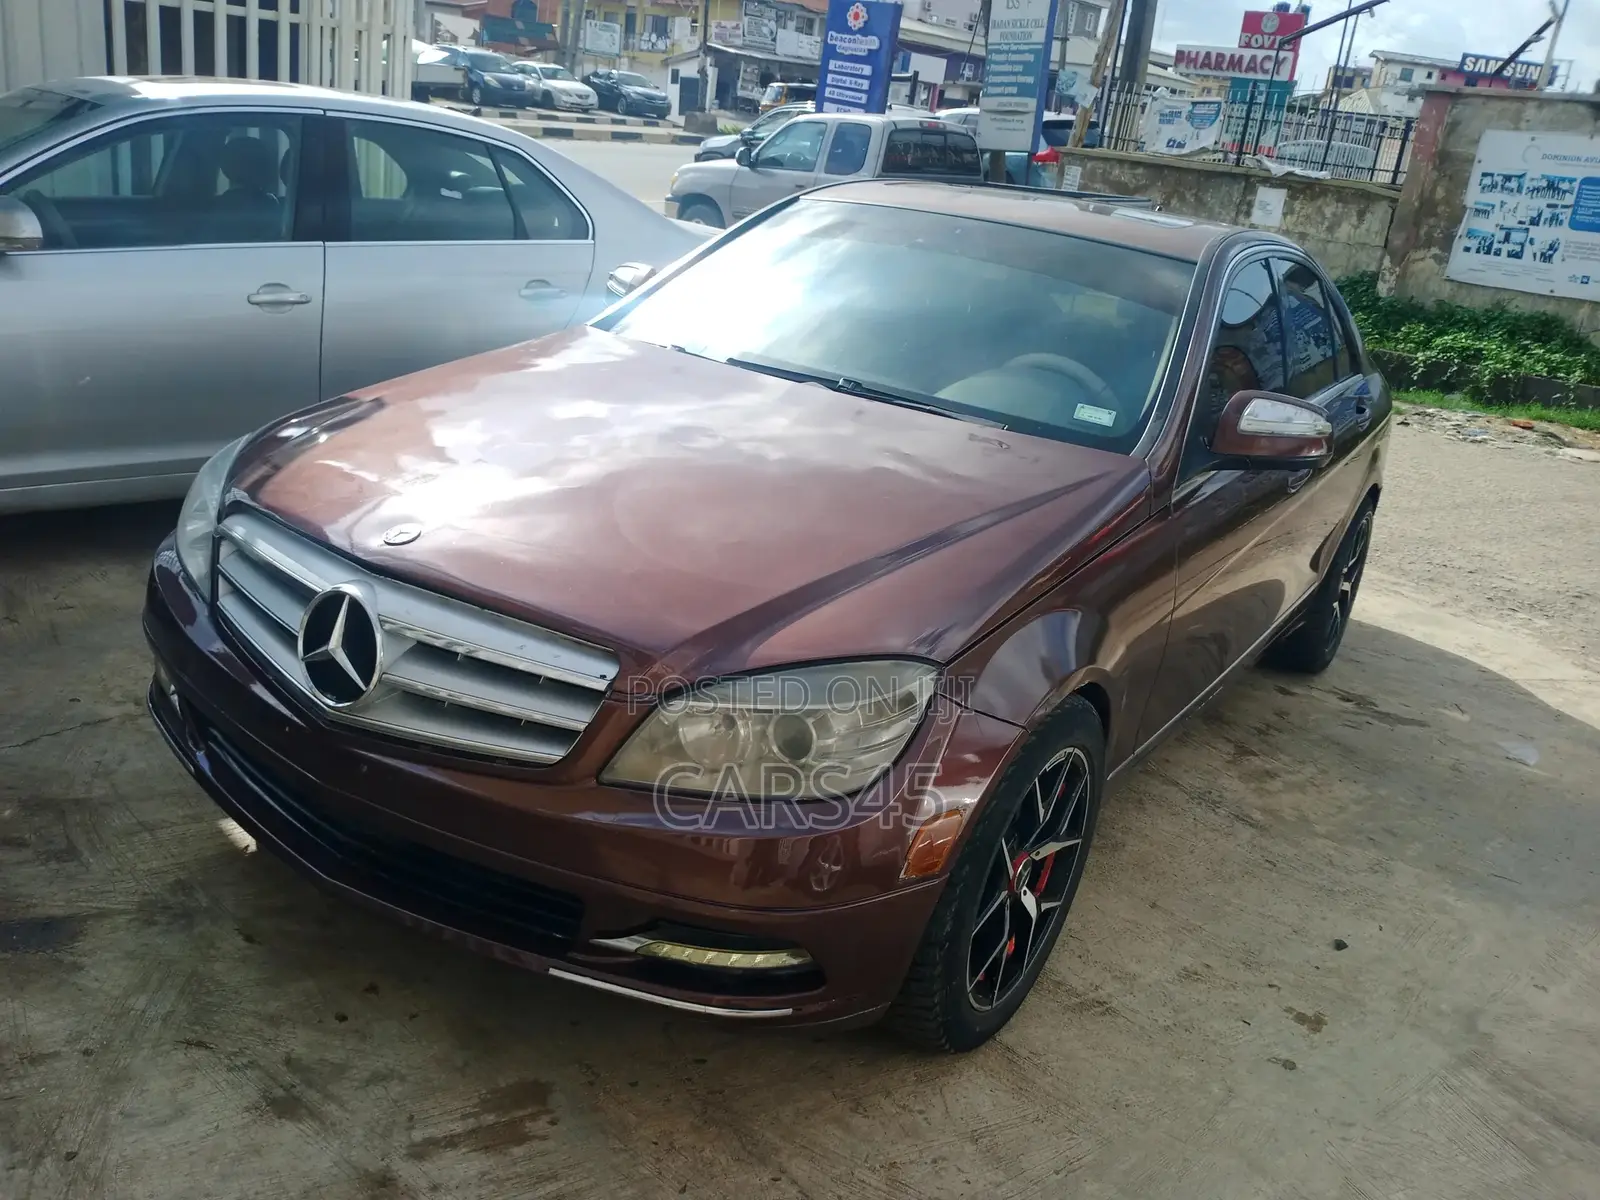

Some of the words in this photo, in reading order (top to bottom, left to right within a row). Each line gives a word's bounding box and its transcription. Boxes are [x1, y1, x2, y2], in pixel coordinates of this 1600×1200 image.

[834, 62, 865, 73] Laboratory
[1175, 50, 1288, 75] PHARMACY
[1463, 57, 1542, 79] SAMSUN
[831, 76, 847, 86] Digital
[849, 78, 864, 88] X-Ray
[836, 90, 863, 102] Ultrasound
[1541, 153, 1582, 163] DOMINION
